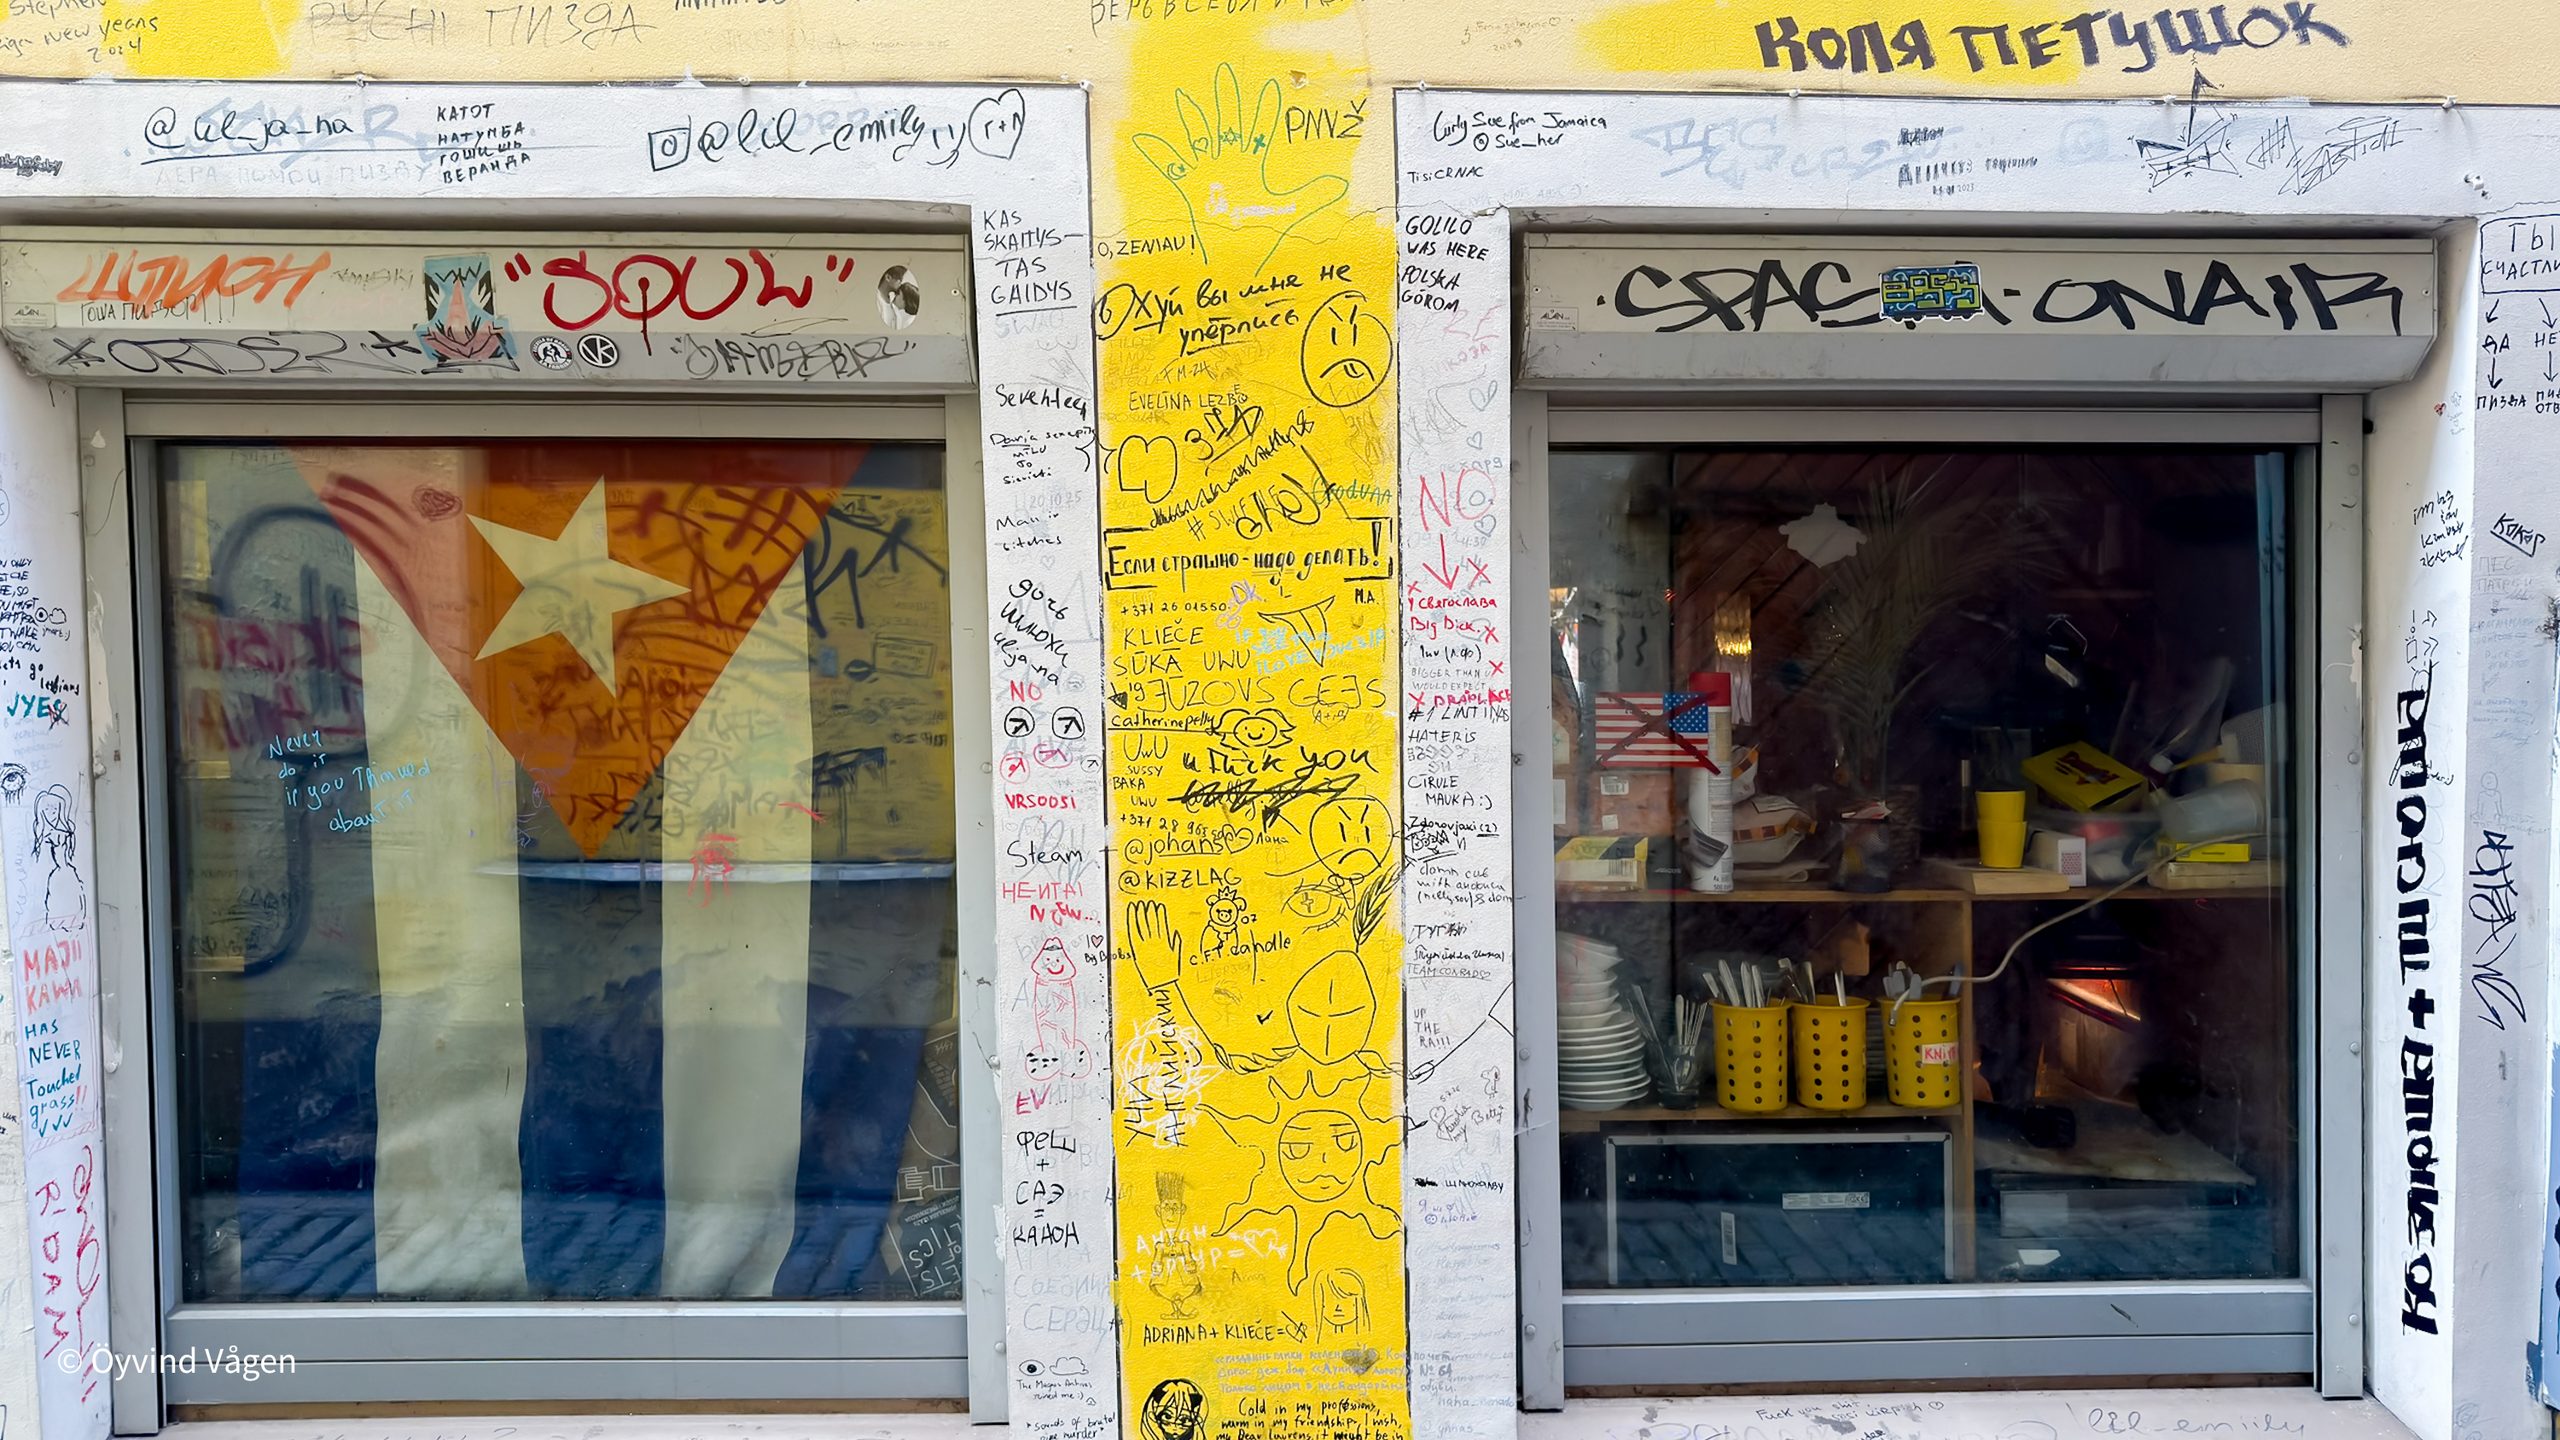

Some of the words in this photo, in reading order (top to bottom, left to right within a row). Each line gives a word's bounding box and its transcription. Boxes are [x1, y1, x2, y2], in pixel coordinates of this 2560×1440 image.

[0, 36, 33, 57] iga
[1754, 15, 1937, 74] КОЛЯ
[1949, 2, 2351, 73] ПЕТУШОК
[1508, 111, 1536, 133] from
[1541, 111, 1608, 130] Jamaica
[983, 209, 1022, 231] KAS
[1406, 241, 1437, 258] WAS
[1446, 241, 1489, 262] HERE
[995, 256, 1047, 279] TAS
[990, 280, 1073, 305] GAIDYS
[1419, 467, 1497, 532] NO
[1109, 545, 1155, 577] Если
[1410, 616, 1438, 641] Big
[1009, 679, 1043, 703] NO
[307, 777, 345, 811] you
[1006, 839, 1084, 869] Steam
[1001, 881, 1084, 903] HENTAI
[25, 1021, 60, 1040] HAS
[1413, 1021, 1441, 1035] THE
[29, 1038, 81, 1069] NEVER
[1238, 1396, 1267, 1416] Cold
[1274, 1400, 1288, 1414] in
[1296, 1400, 1312, 1418] my
[1755, 1407, 1793, 1422] Fuck
